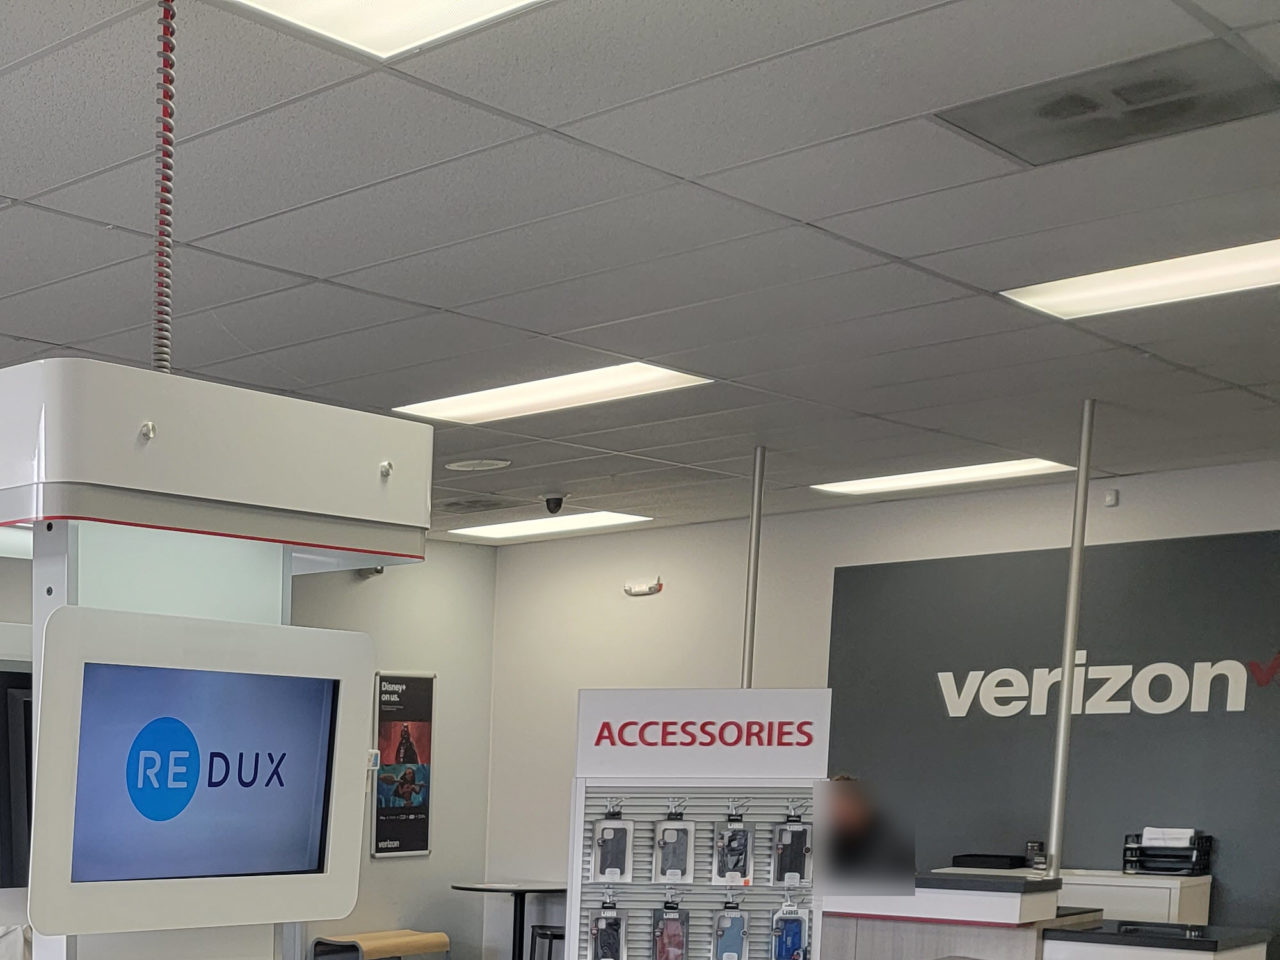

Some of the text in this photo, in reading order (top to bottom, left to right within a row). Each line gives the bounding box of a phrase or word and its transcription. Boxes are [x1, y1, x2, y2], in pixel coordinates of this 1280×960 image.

[381, 681, 406, 693] Disney+
[937, 650, 1248, 717] verizon
[594, 720, 814, 747] ACCESSORIES
[378, 840, 400, 848] verizon
